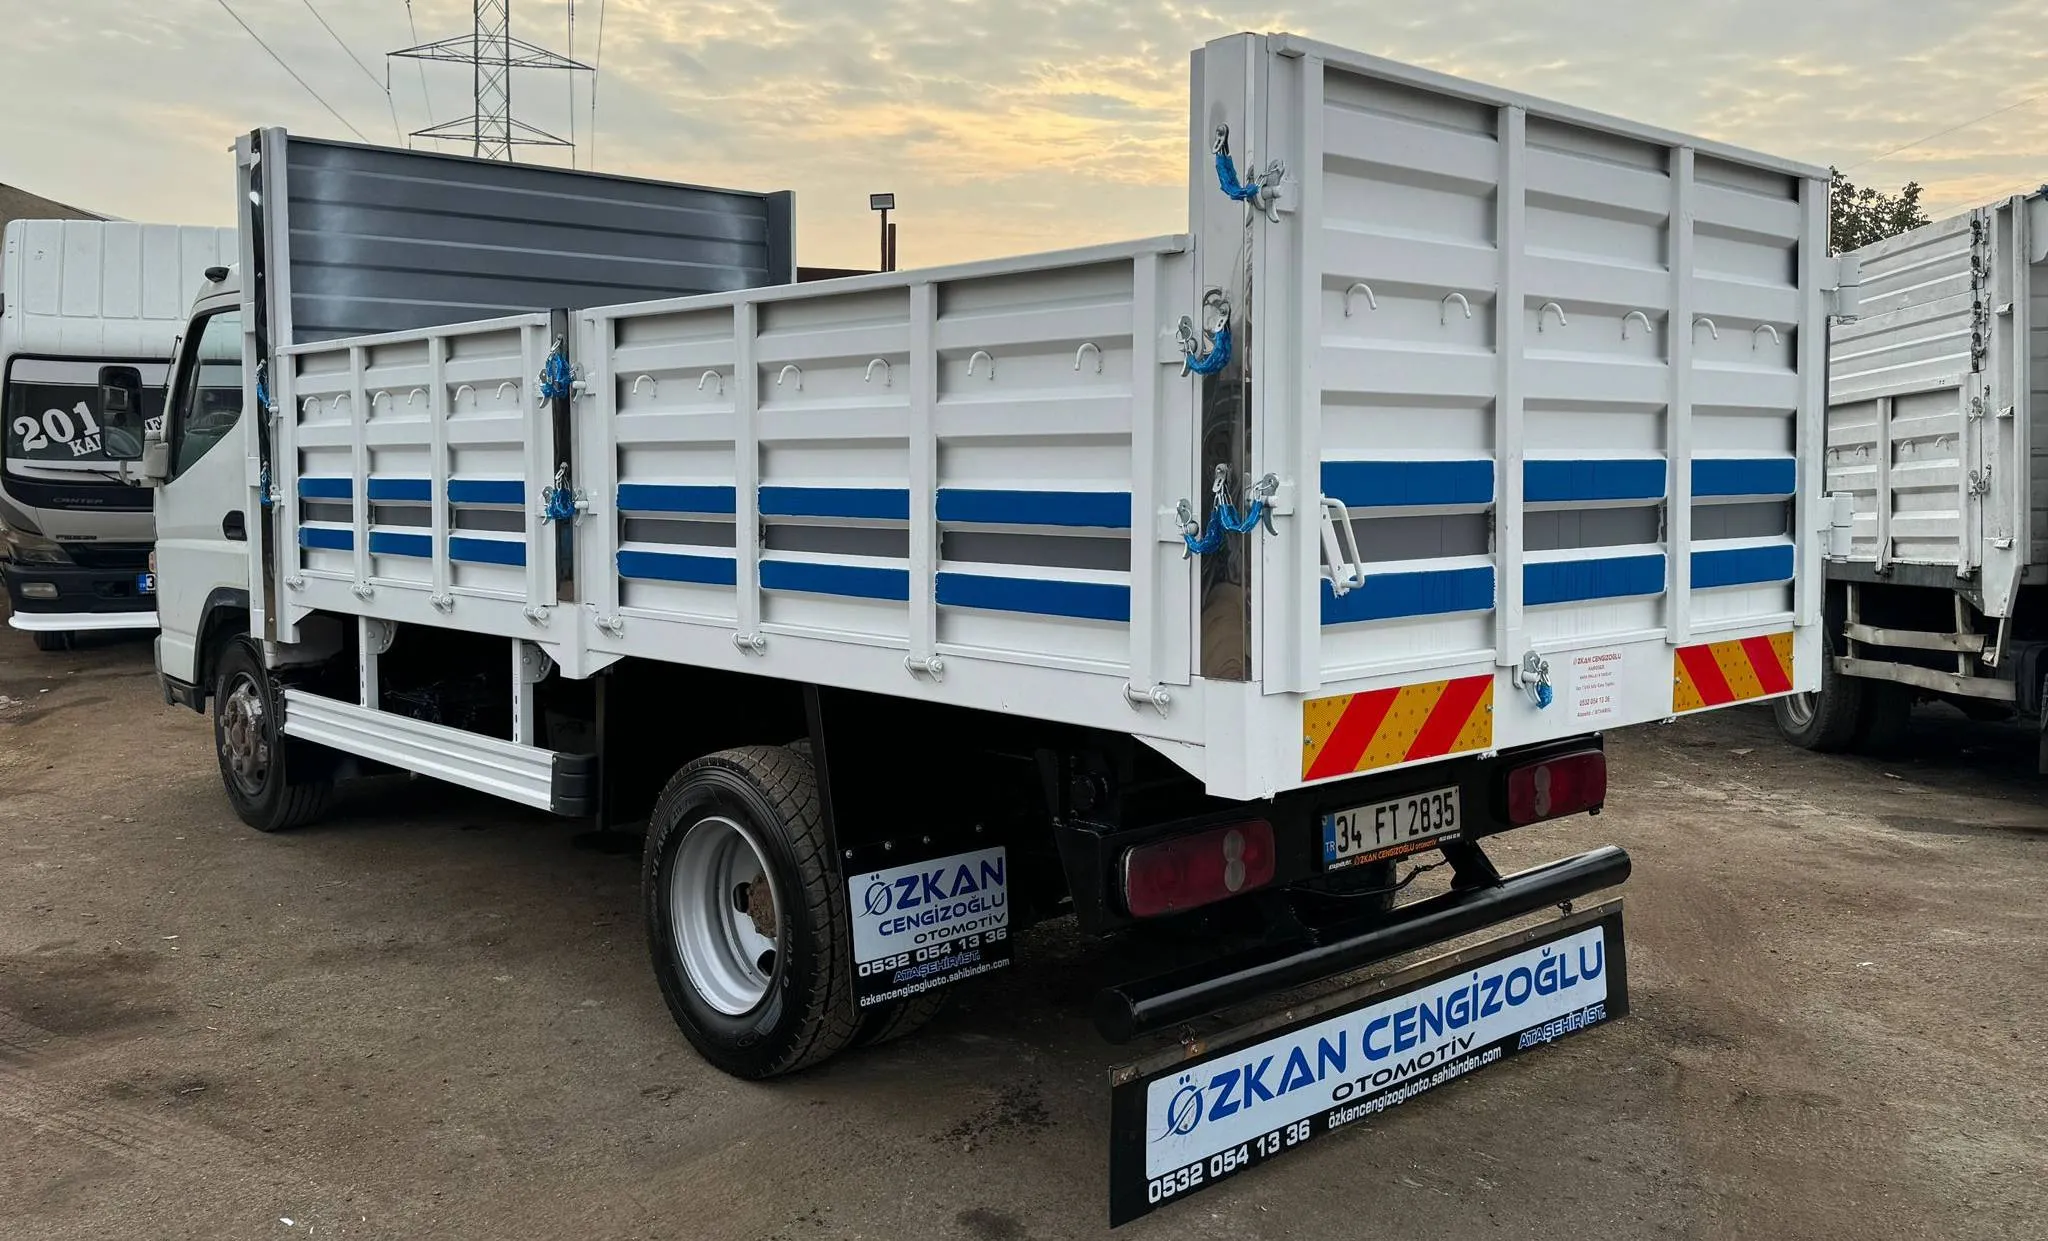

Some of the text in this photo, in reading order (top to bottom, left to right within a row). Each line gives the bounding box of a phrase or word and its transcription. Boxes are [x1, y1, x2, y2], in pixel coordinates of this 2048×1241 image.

[1326, 842, 1336, 852] TR
[1337, 791, 1455, 853] 34 FT 2835
[859, 857, 1005, 917] ÖZKAN
[878, 892, 1005, 936] CENGİZOĞLU
[859, 928, 1007, 977] 0532 054 13 36
[914, 913, 1006, 944] OTOMOTİV
[860, 958, 1010, 1007] özkancengizogluoto.sahibinden.com
[1151, 941, 1602, 1143] ÖZKAN CENGİZOĞLU
[1332, 1032, 1475, 1102] OTOMOTİV
[1328, 1046, 1502, 1130] özkancengizogluoto.sahibinden.com
[1149, 1119, 1311, 1204] 0532 054 13 36
